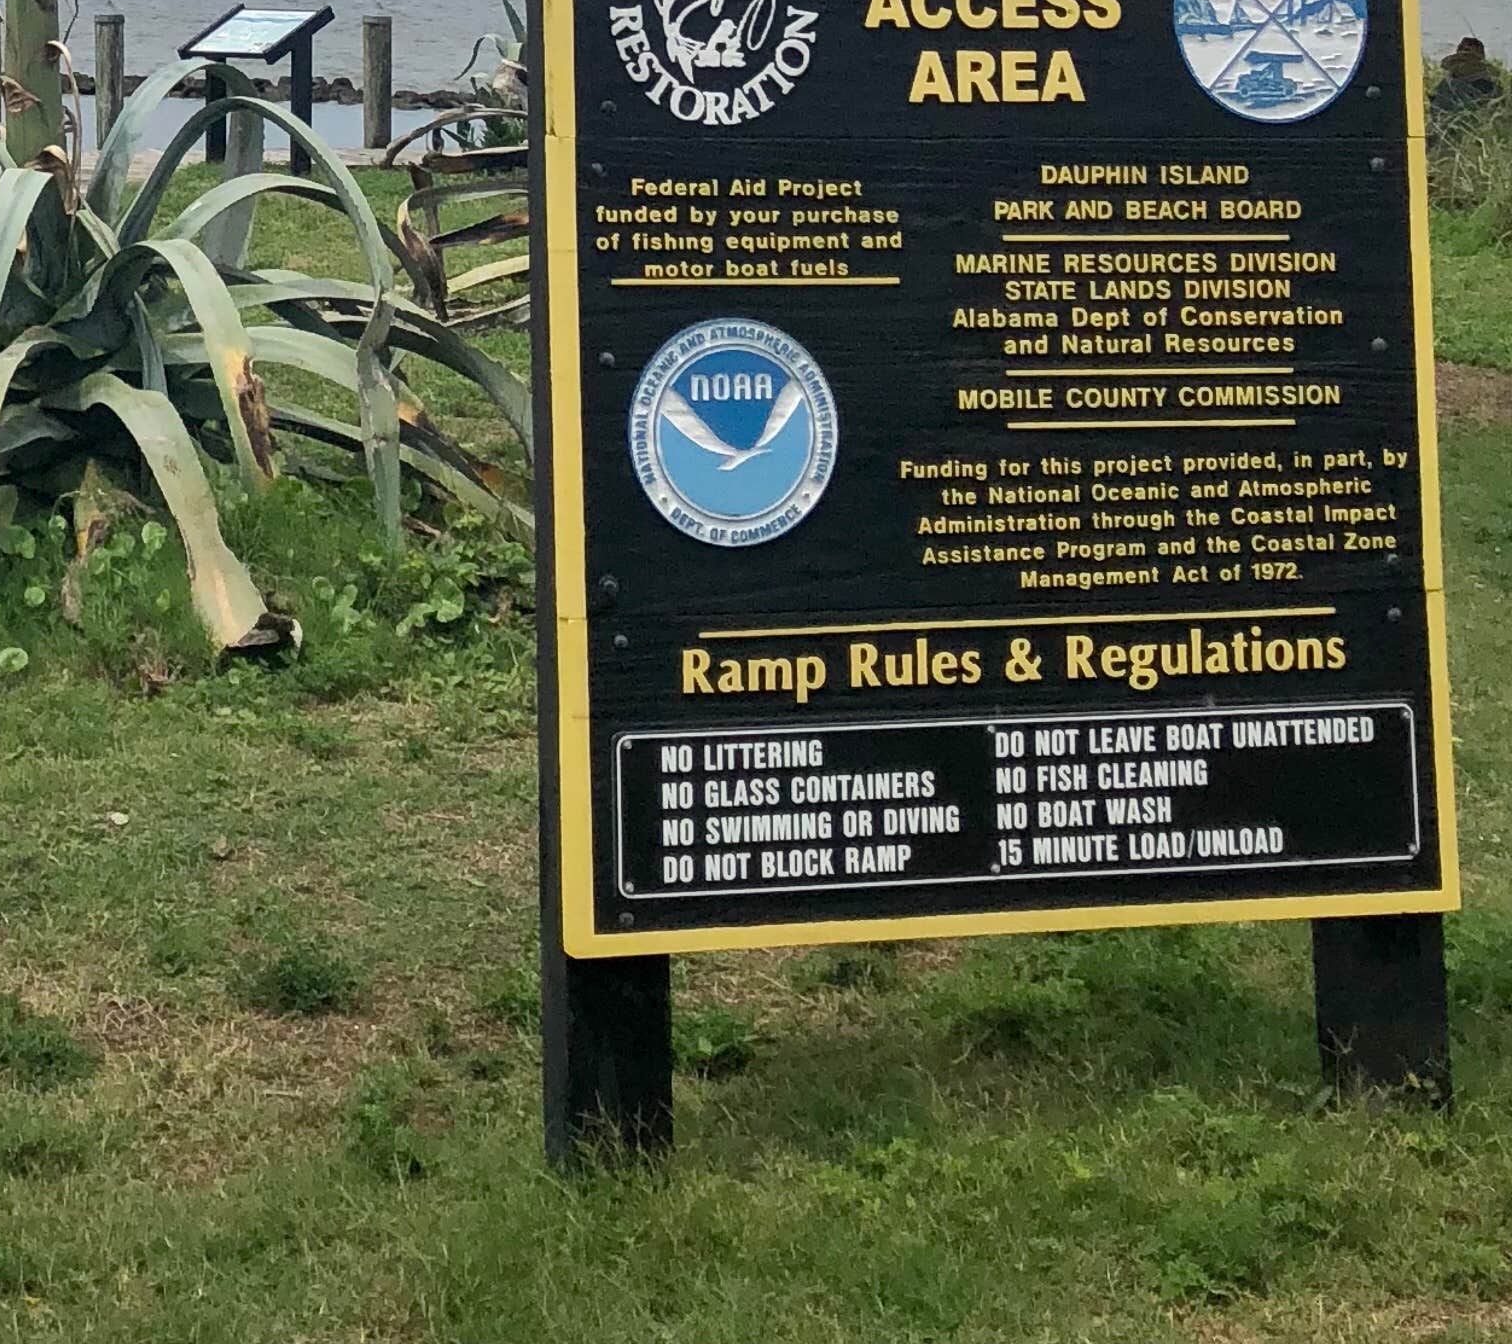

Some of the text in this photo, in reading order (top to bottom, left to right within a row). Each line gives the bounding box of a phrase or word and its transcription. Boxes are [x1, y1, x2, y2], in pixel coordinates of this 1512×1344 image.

[610, 5, 819, 125] RESTORATION
[908, 49, 1086, 103] AREA
[631, 178, 862, 200] Federal Aid Project
[1041, 164, 1249, 185] DAUPHIN ISLAND
[595, 205, 899, 227] funded by your purchase
[994, 199, 1302, 220] PARK AND BEACH BOARD
[596, 231, 902, 254] of fishing equipment and
[644, 258, 849, 278] motor boat fuels
[956, 252, 1336, 274] MARINE RESOURCES DIVISION
[1005, 279, 1291, 301] STATE LANDS DIVISION
[952, 305, 1343, 331] Alabama Dept of Conservation
[1004, 333, 1295, 355] and Natural Resources
[633, 326, 834, 486] NATIONAL OCEANIC AND ATMOSPHERIC ADMINISTRATION
[958, 384, 1340, 410] MOBILE COUNTY COMMISSION
[900, 448, 1408, 481] Funding for this project provided, in part, by
[941, 476, 1372, 506] the National Oceanic and Atmospheric
[709, 529, 730, 542] OF
[731, 503, 803, 544] COMMERCE
[917, 503, 1396, 535] Administration through the Coastal Impact
[922, 532, 1397, 565] Assistance Program and the Coastal Zone
[1020, 561, 1303, 590] Management Act of 1972.
[682, 625, 1346, 704] Ramp Rules & Regulations
[995, 716, 1374, 758] DO NOT LEAVE BOAT UNATTENDED
[661, 739, 823, 773] NO LITTERING
[661, 770, 935, 810] NO GLASS CONTAINERS
[995, 758, 1208, 794] NO FISH CLEANING
[662, 805, 960, 847] NO SWIMMING OR DIVING
[996, 796, 1172, 830] NO BOAT WASH
[998, 826, 1284, 866] 15 MINUTE LOAD/UNLOAD
[663, 844, 912, 884] DO NOT BLOCK RAMP
